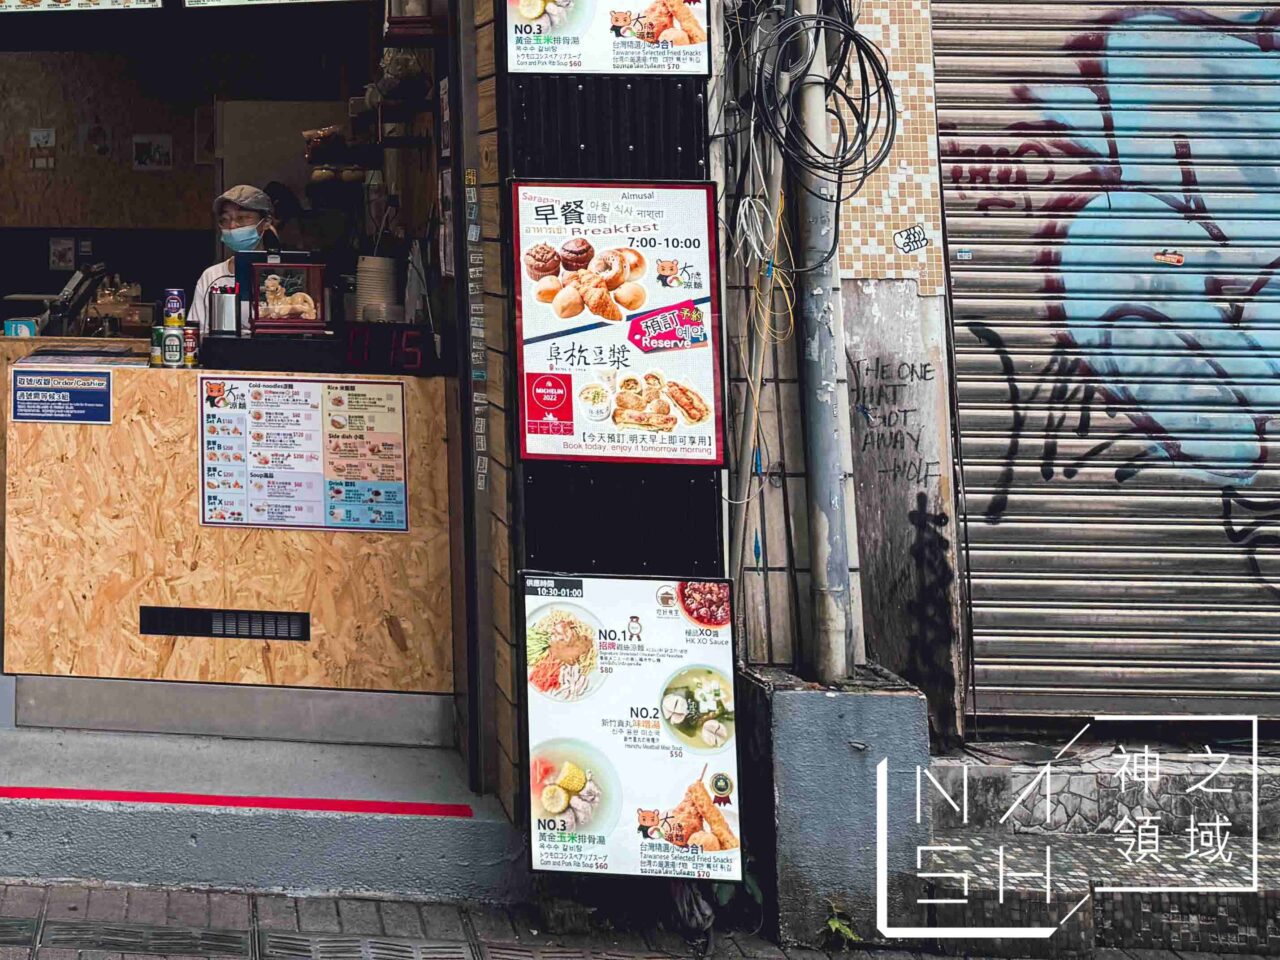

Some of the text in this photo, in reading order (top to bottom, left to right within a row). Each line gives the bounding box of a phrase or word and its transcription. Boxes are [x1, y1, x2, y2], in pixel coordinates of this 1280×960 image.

[514, 24, 542, 34] NO.3
[534, 200, 585, 225] 早餐
[571, 223, 659, 236] Breakfast
[628, 237, 701, 248] 7:00-10:00
[641, 310, 679, 336] 預訂
[642, 336, 691, 348] Reserve
[854, 358, 935, 380] THE ONE
[867, 409, 917, 428] GOT
[862, 424, 922, 451] AWAY
[563, 442, 583, 450] Book
[611, 443, 632, 452] enjoy
[641, 444, 677, 452] tomorrow
[679, 446, 712, 454] morning
[537, 587, 582, 597] 10:30-01:00
[598, 629, 627, 641] NO.1
[630, 707, 659, 719] NO.2
[537, 819, 566, 831] NO.3
[640, 852, 669, 860] Taiwanese
[671, 853, 695, 861] Selected
[595, 862, 608, 870] $60
